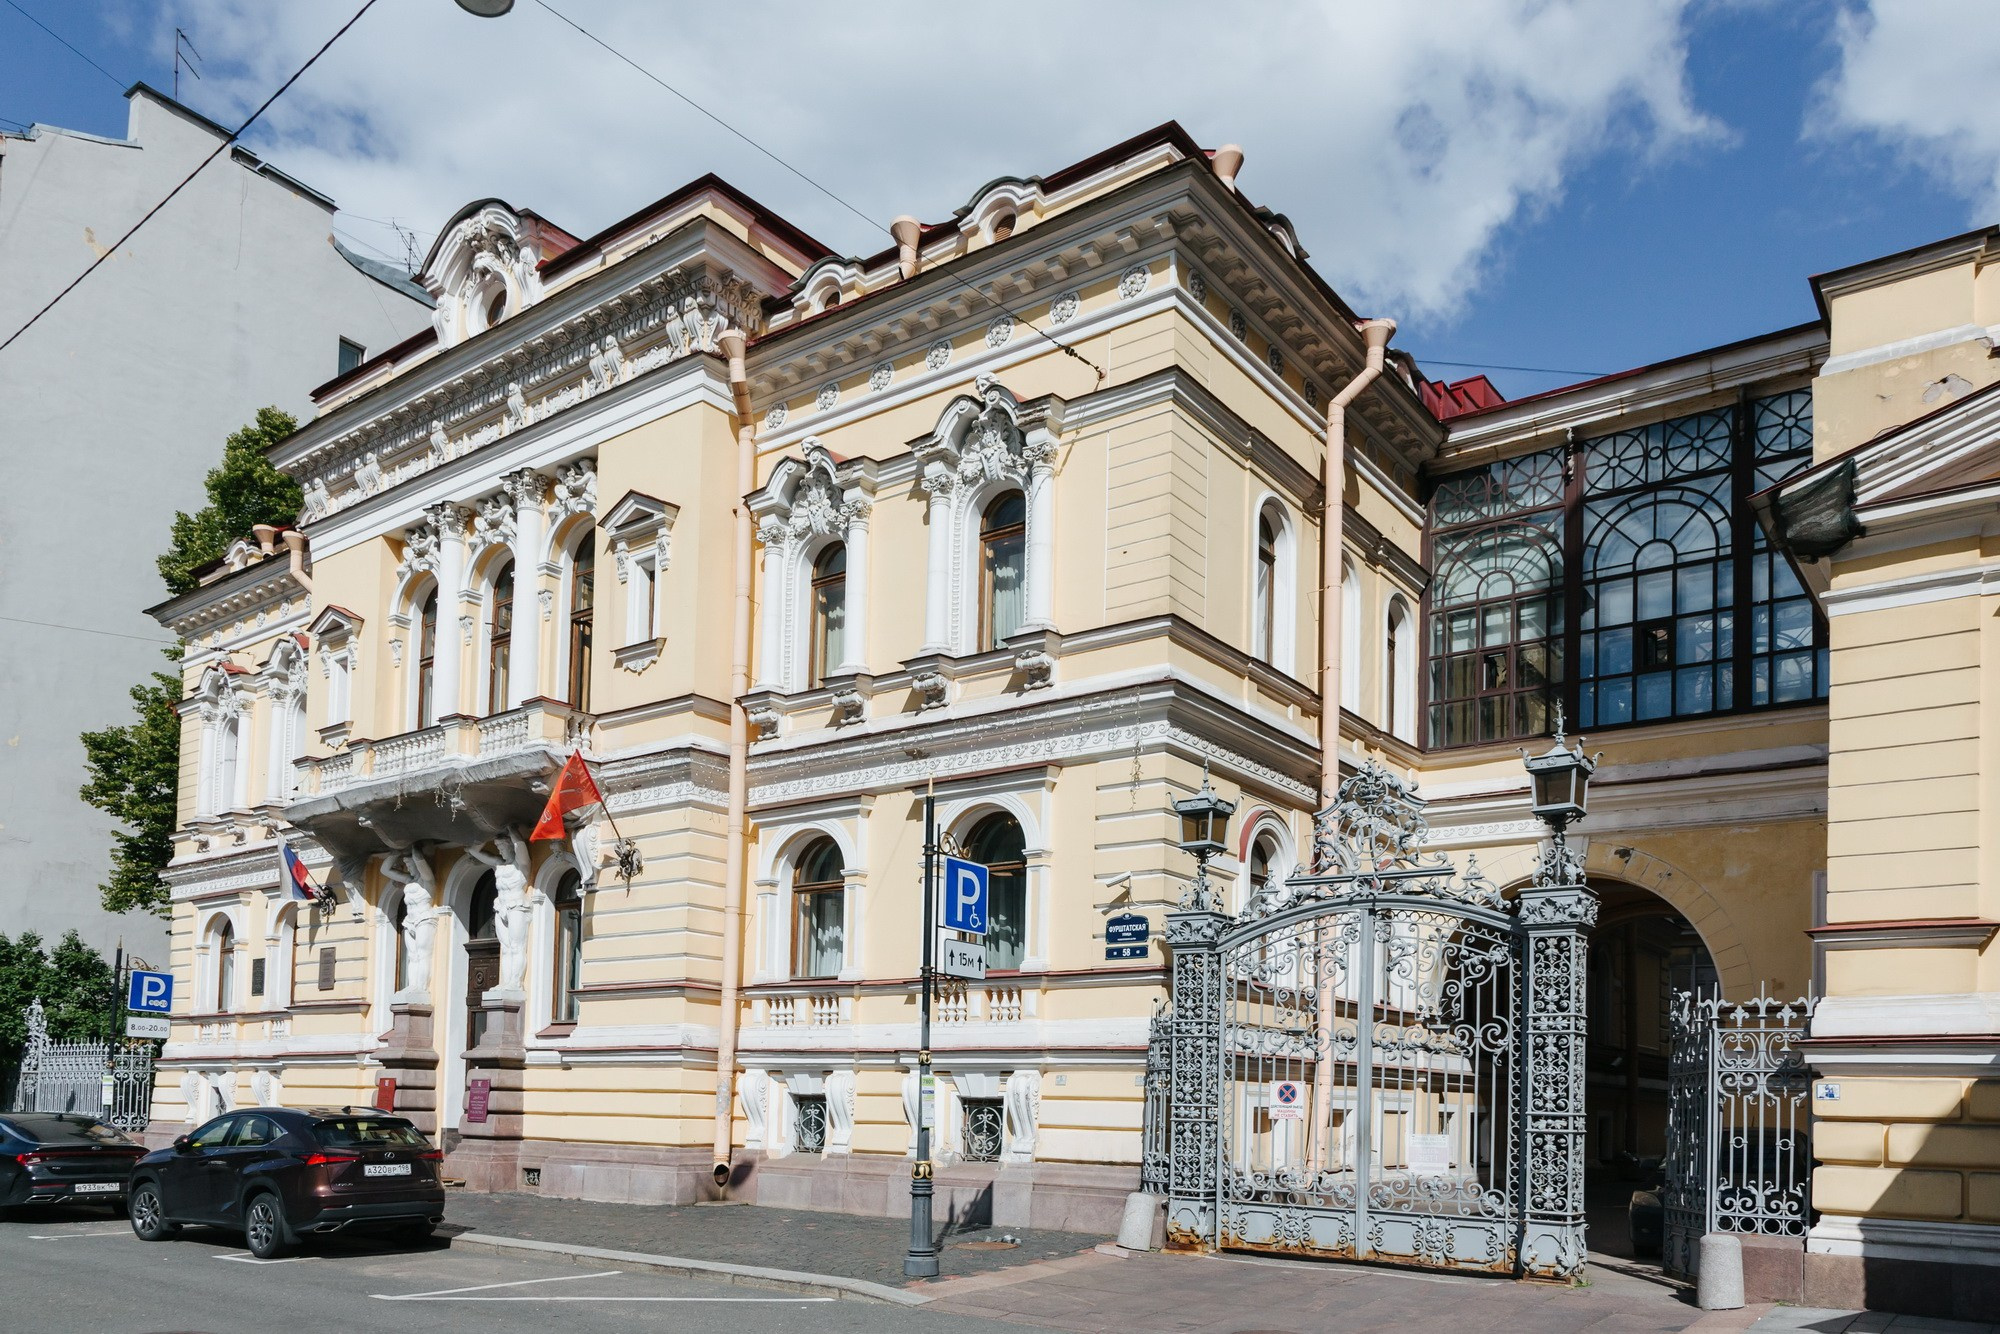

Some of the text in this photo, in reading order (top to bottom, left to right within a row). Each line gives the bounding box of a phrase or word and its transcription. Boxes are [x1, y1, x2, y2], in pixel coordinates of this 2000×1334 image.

[957, 868, 980, 922] P
[1108, 924, 1147, 933] ФУРШТАТСКАЯ
[1122, 948, 1131, 957] 58
[141, 975, 166, 1007] P
